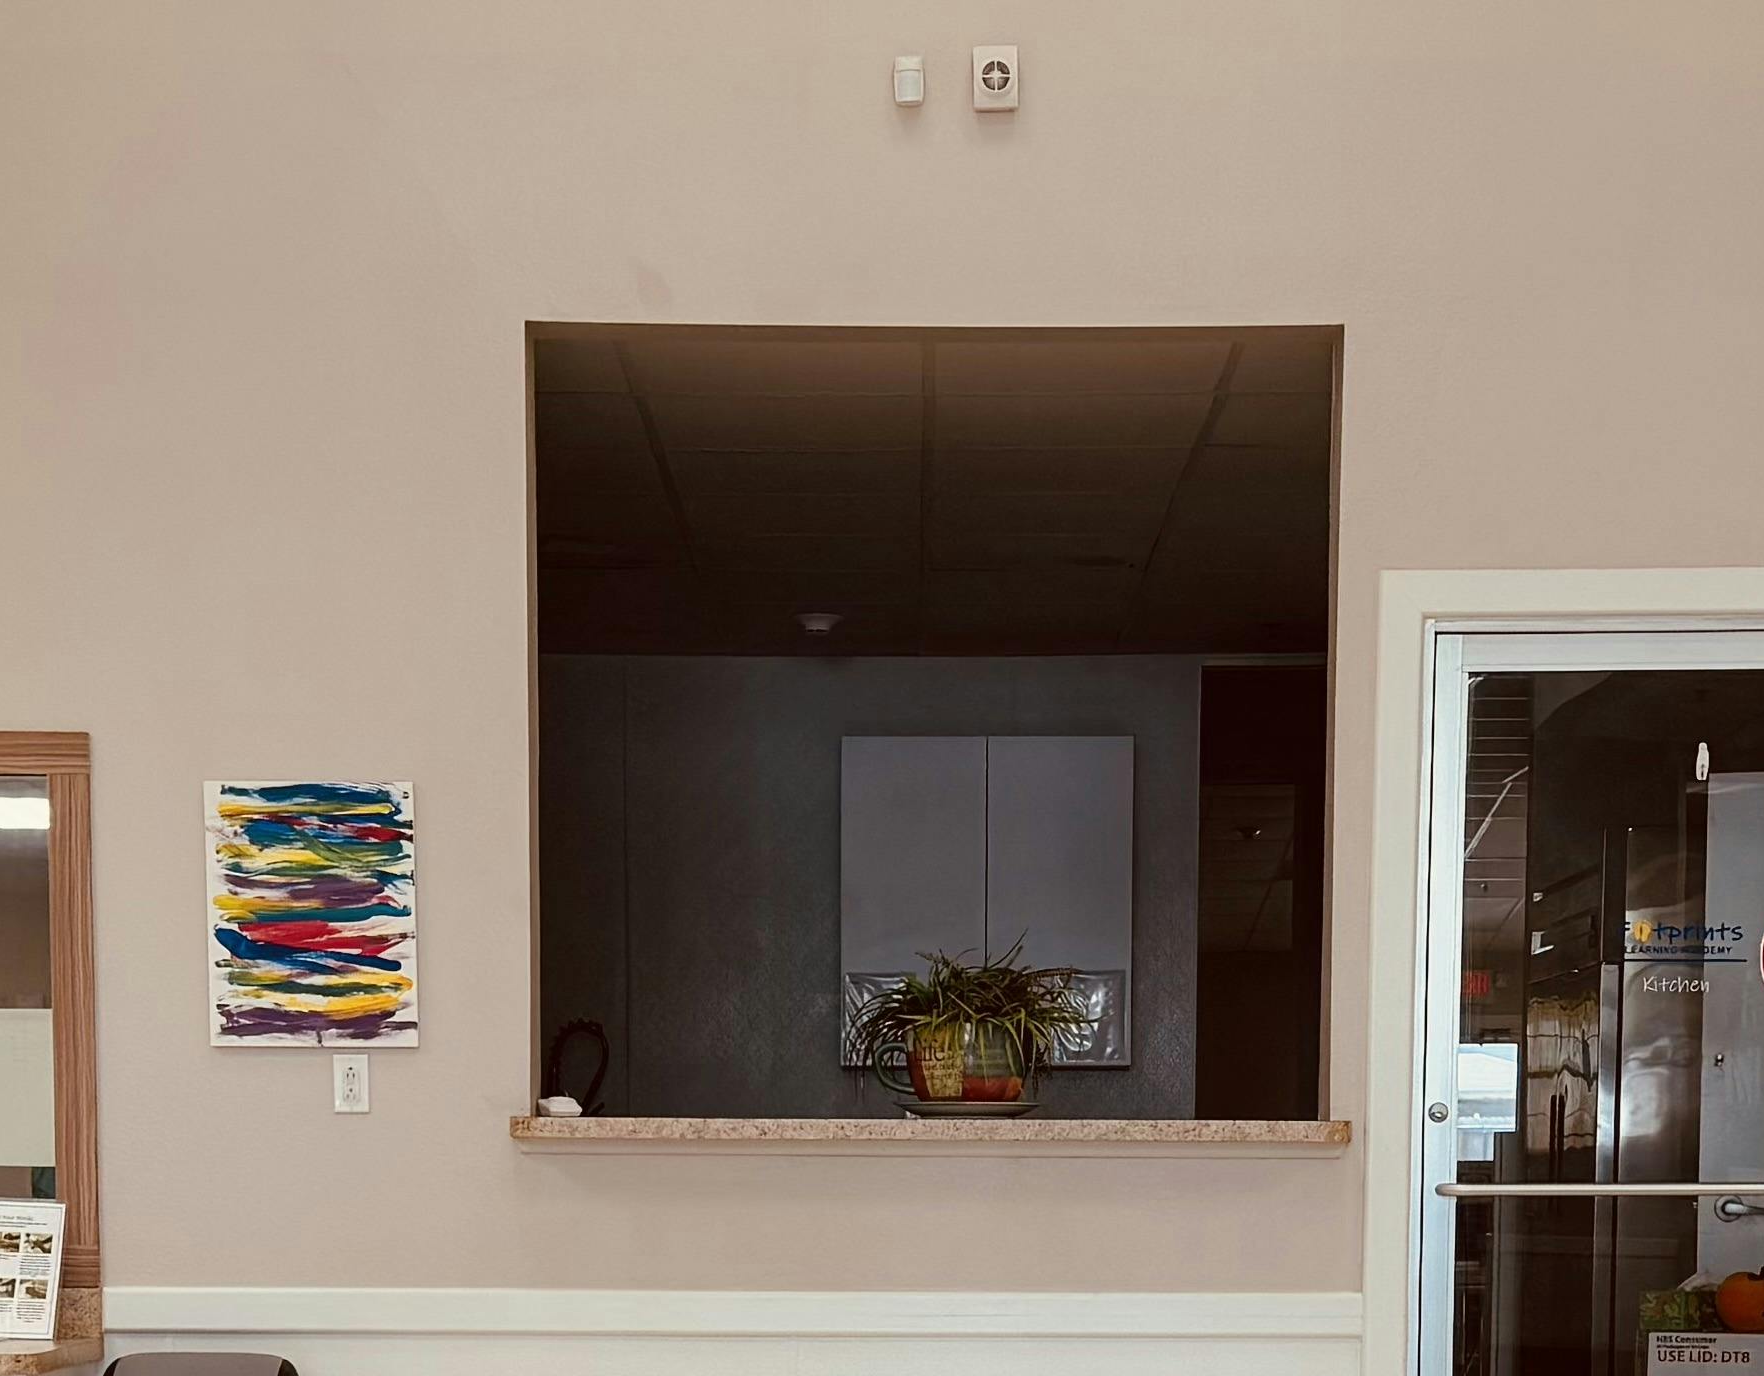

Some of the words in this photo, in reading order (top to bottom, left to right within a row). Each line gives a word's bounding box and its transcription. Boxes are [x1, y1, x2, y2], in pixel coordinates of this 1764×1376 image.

[1642, 976, 1710, 993] Kitchen
[1657, 1350, 1685, 1363] USE
[1689, 1350, 1718, 1363] LID:
[1721, 1351, 1750, 1363] DT8
